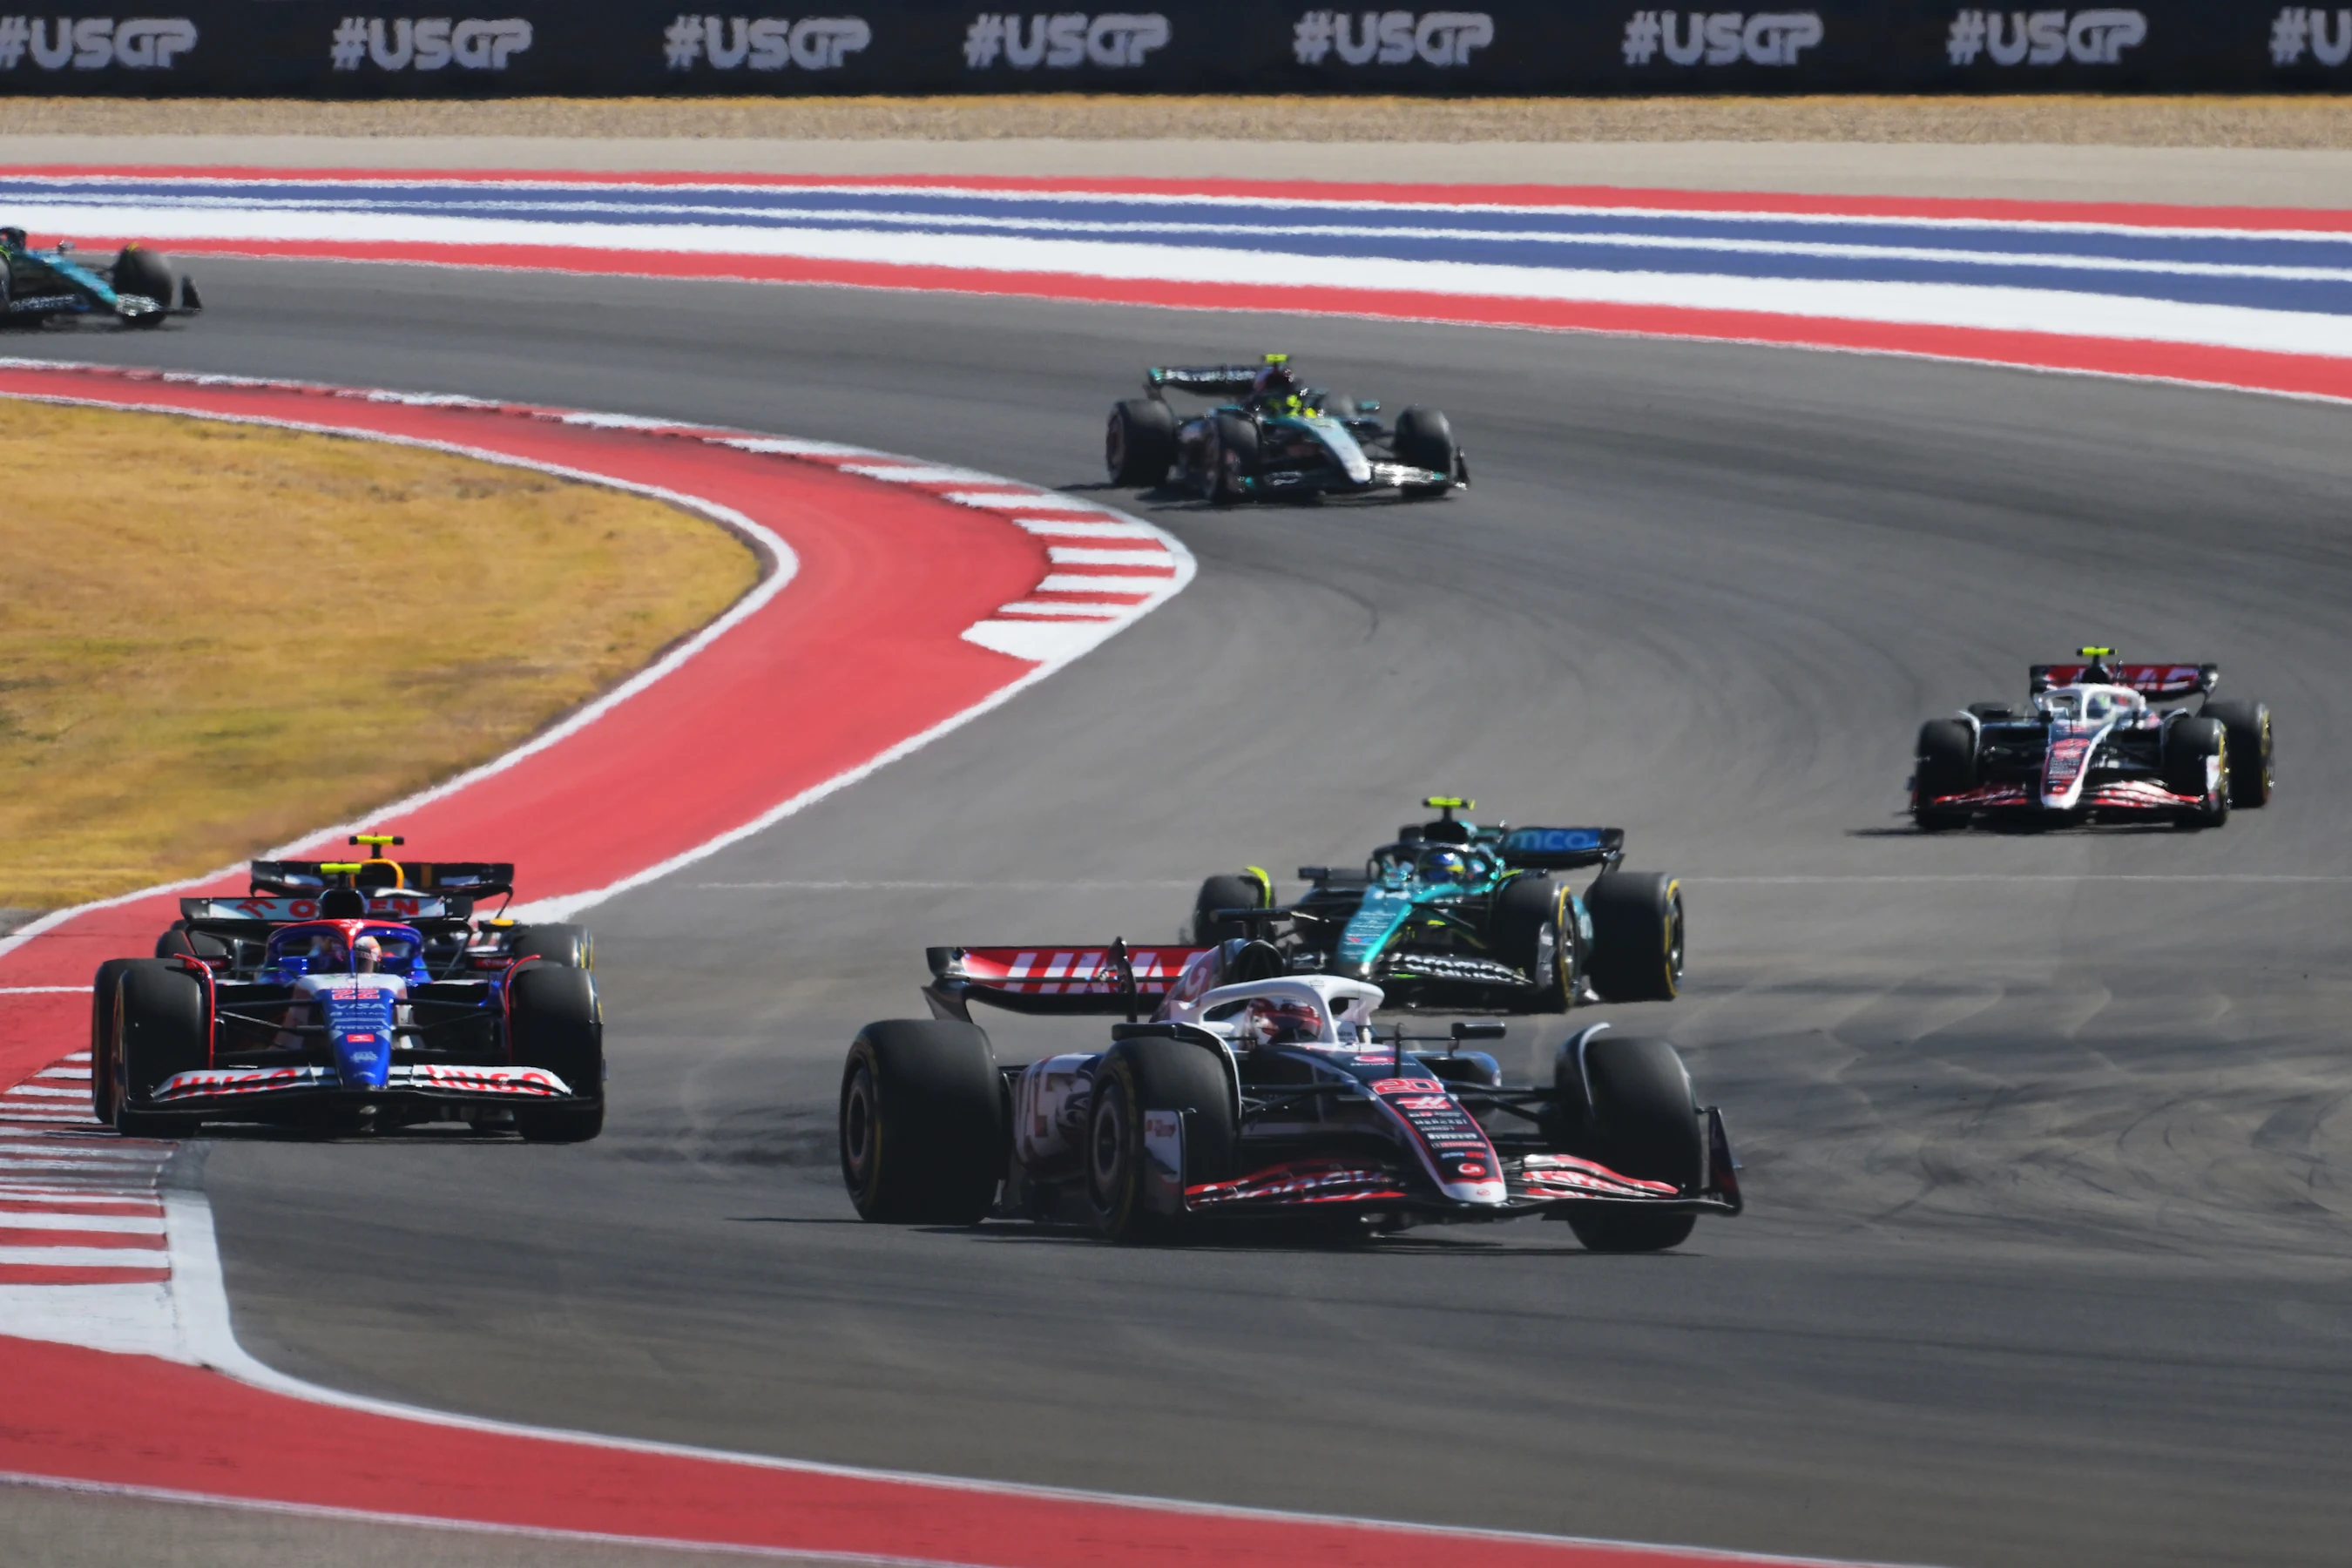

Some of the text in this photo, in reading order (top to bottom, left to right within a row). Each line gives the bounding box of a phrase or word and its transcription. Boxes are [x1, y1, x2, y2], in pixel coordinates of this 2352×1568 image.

[0, 16, 199, 69] #USGP
[331, 17, 533, 71] #USGP
[665, 15, 871, 71] #USGP
[963, 12, 1170, 68] #USGP
[1294, 10, 1494, 66] #USGP
[1622, 10, 1823, 65] #USGP
[1947, 9, 2146, 65] #USGP
[332, 989, 380, 1000] 22
[168, 1068, 297, 1100] HUGO
[425, 1064, 551, 1096] HUGO
[1370, 1078, 1446, 1095] 20
